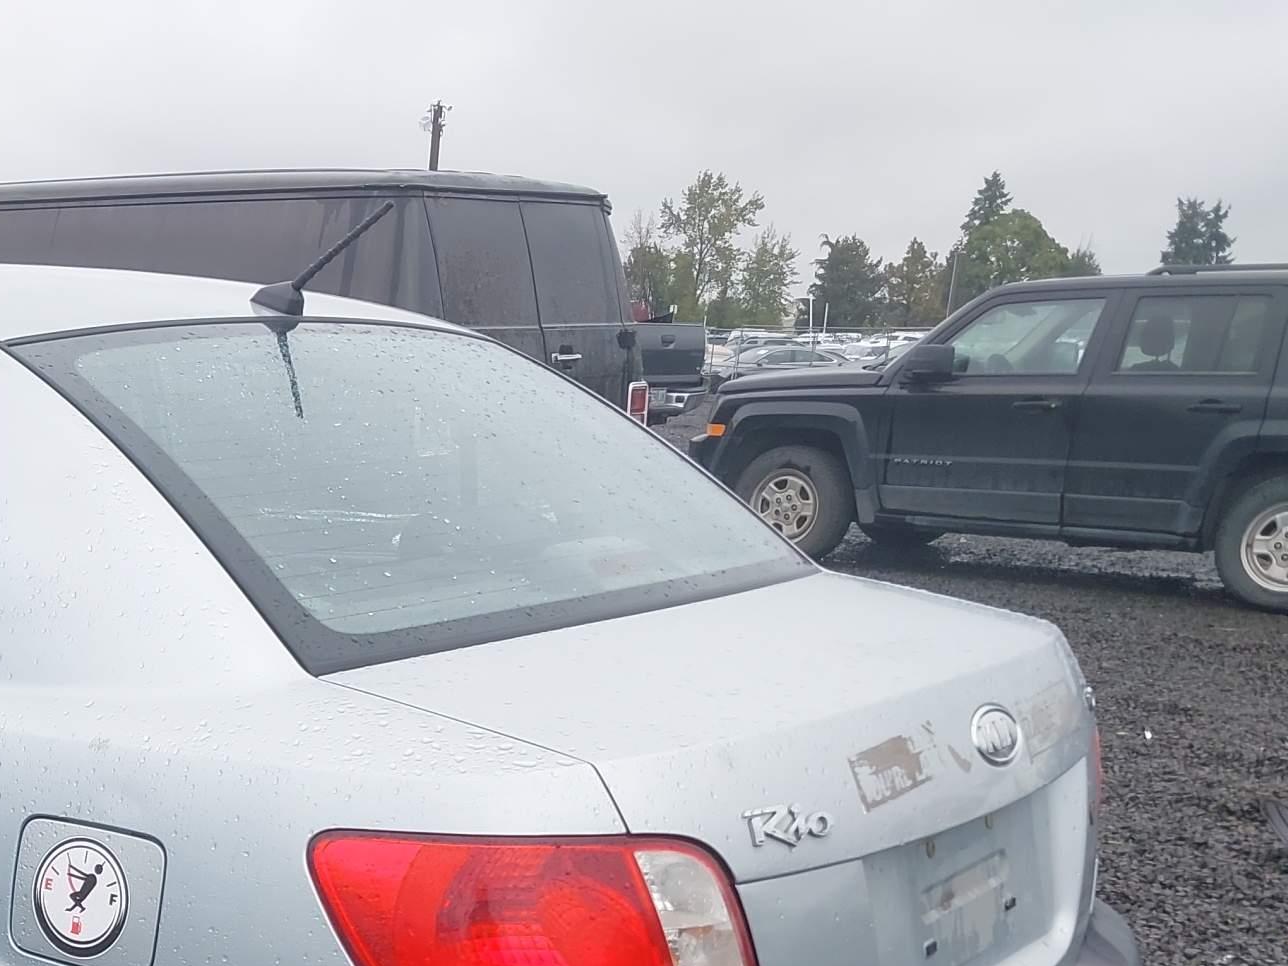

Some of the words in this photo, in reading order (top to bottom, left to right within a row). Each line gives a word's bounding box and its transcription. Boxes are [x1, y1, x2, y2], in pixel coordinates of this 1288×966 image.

[893, 457, 953, 466] PATRIOT
[741, 803, 834, 848] Rio
[44, 878, 54, 891] E
[108, 893, 119, 906] F
